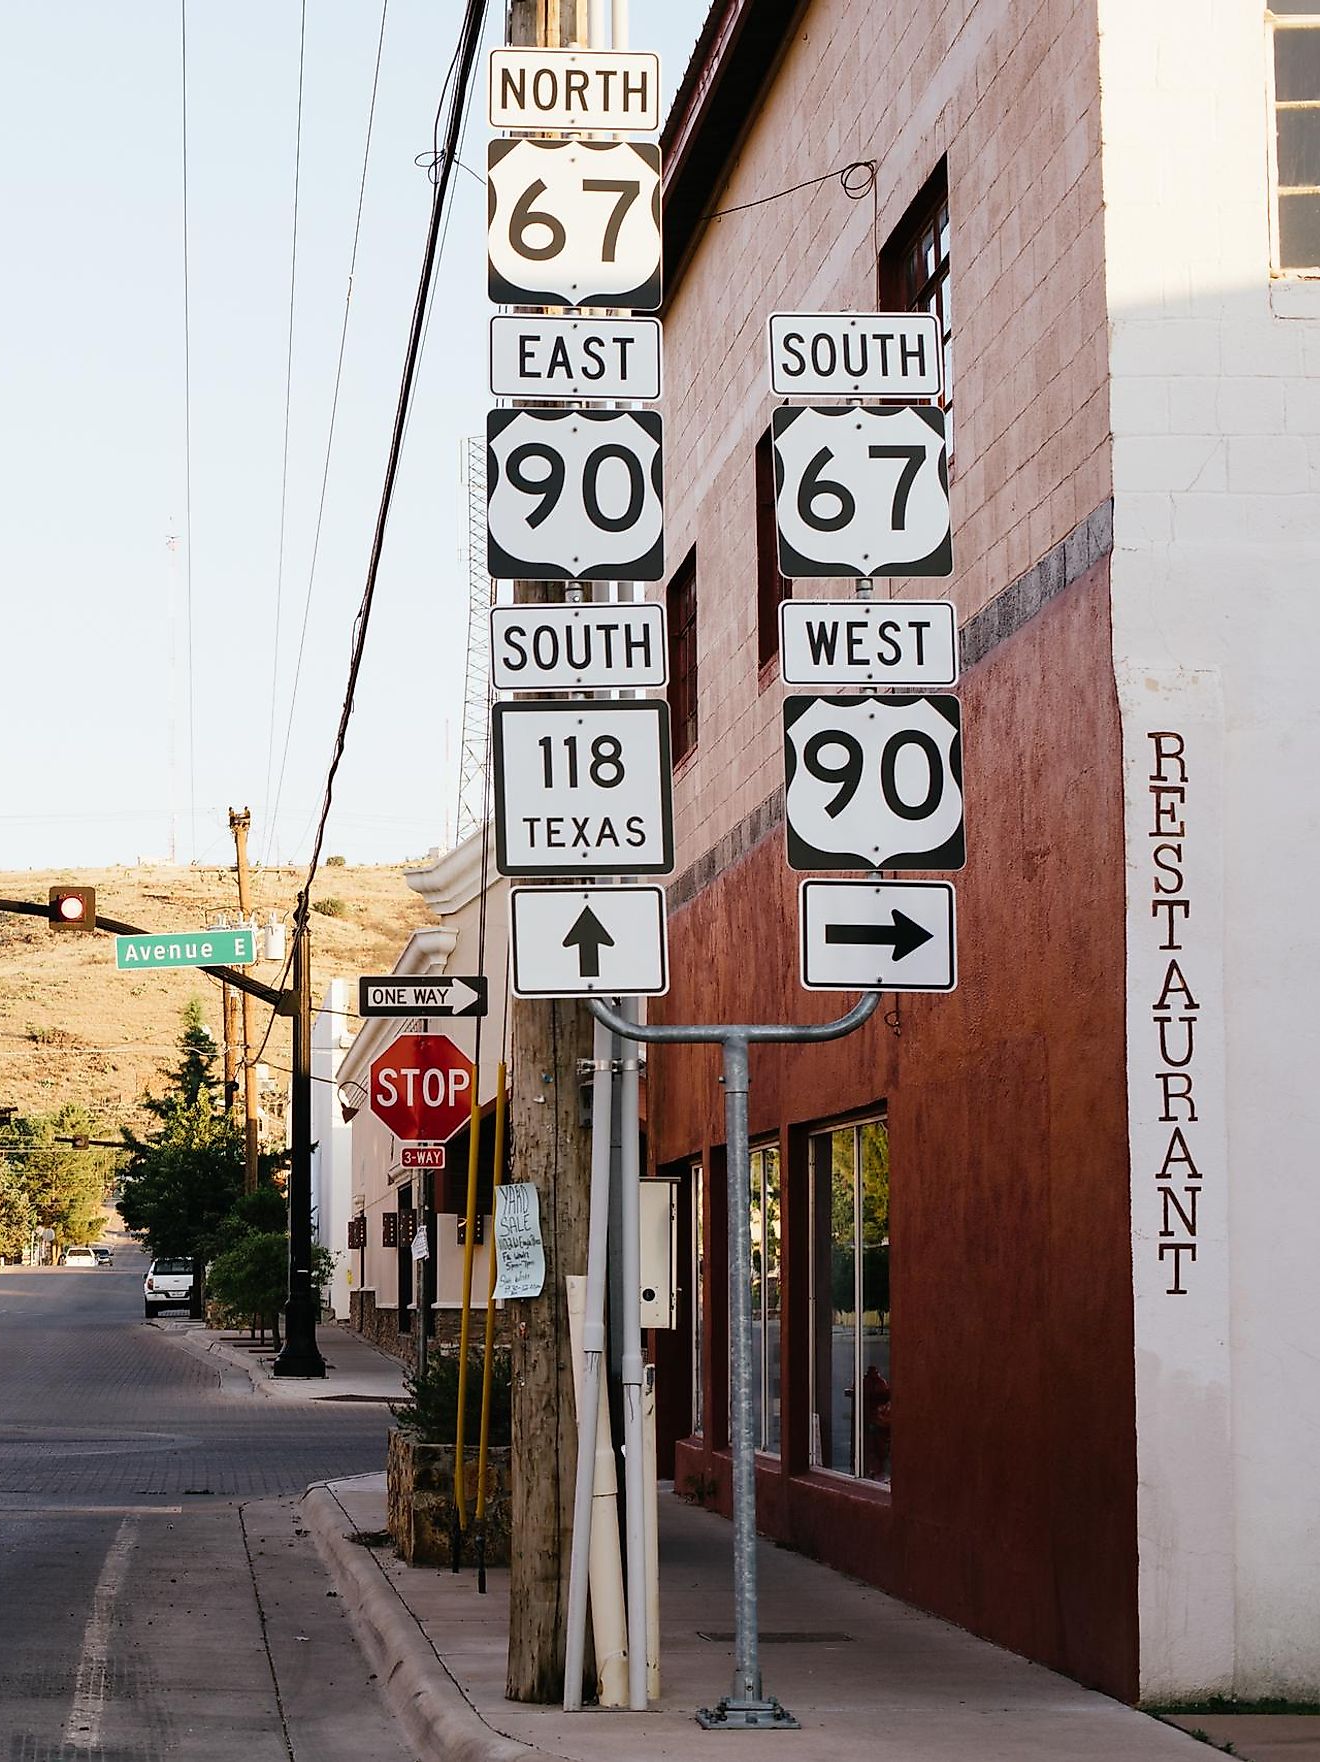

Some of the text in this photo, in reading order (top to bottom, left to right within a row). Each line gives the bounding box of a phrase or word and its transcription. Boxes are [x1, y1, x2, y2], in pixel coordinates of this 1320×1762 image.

[502, 68, 648, 112] NORTH
[509, 178, 641, 262] 67
[520, 335, 634, 380] EAST
[782, 333, 925, 377] SOUTH
[506, 443, 644, 532] 90
[798, 445, 926, 532] 67
[503, 624, 651, 671] SOUTH
[806, 621, 930, 666] WEST
[539, 735, 624, 788] 118
[804, 730, 943, 820] 90
[523, 817, 645, 847] TEXAS
[125, 938, 246, 961] Avenue E
[372, 984, 451, 1005] ONE WAY
[1148, 732, 1204, 1295] RESTAURANT
[376, 1067, 470, 1107] STOP
[404, 1151, 441, 1166] 3-WAY
[499, 1185, 529, 1215] YARD
[500, 1214, 532, 1237] SALE
